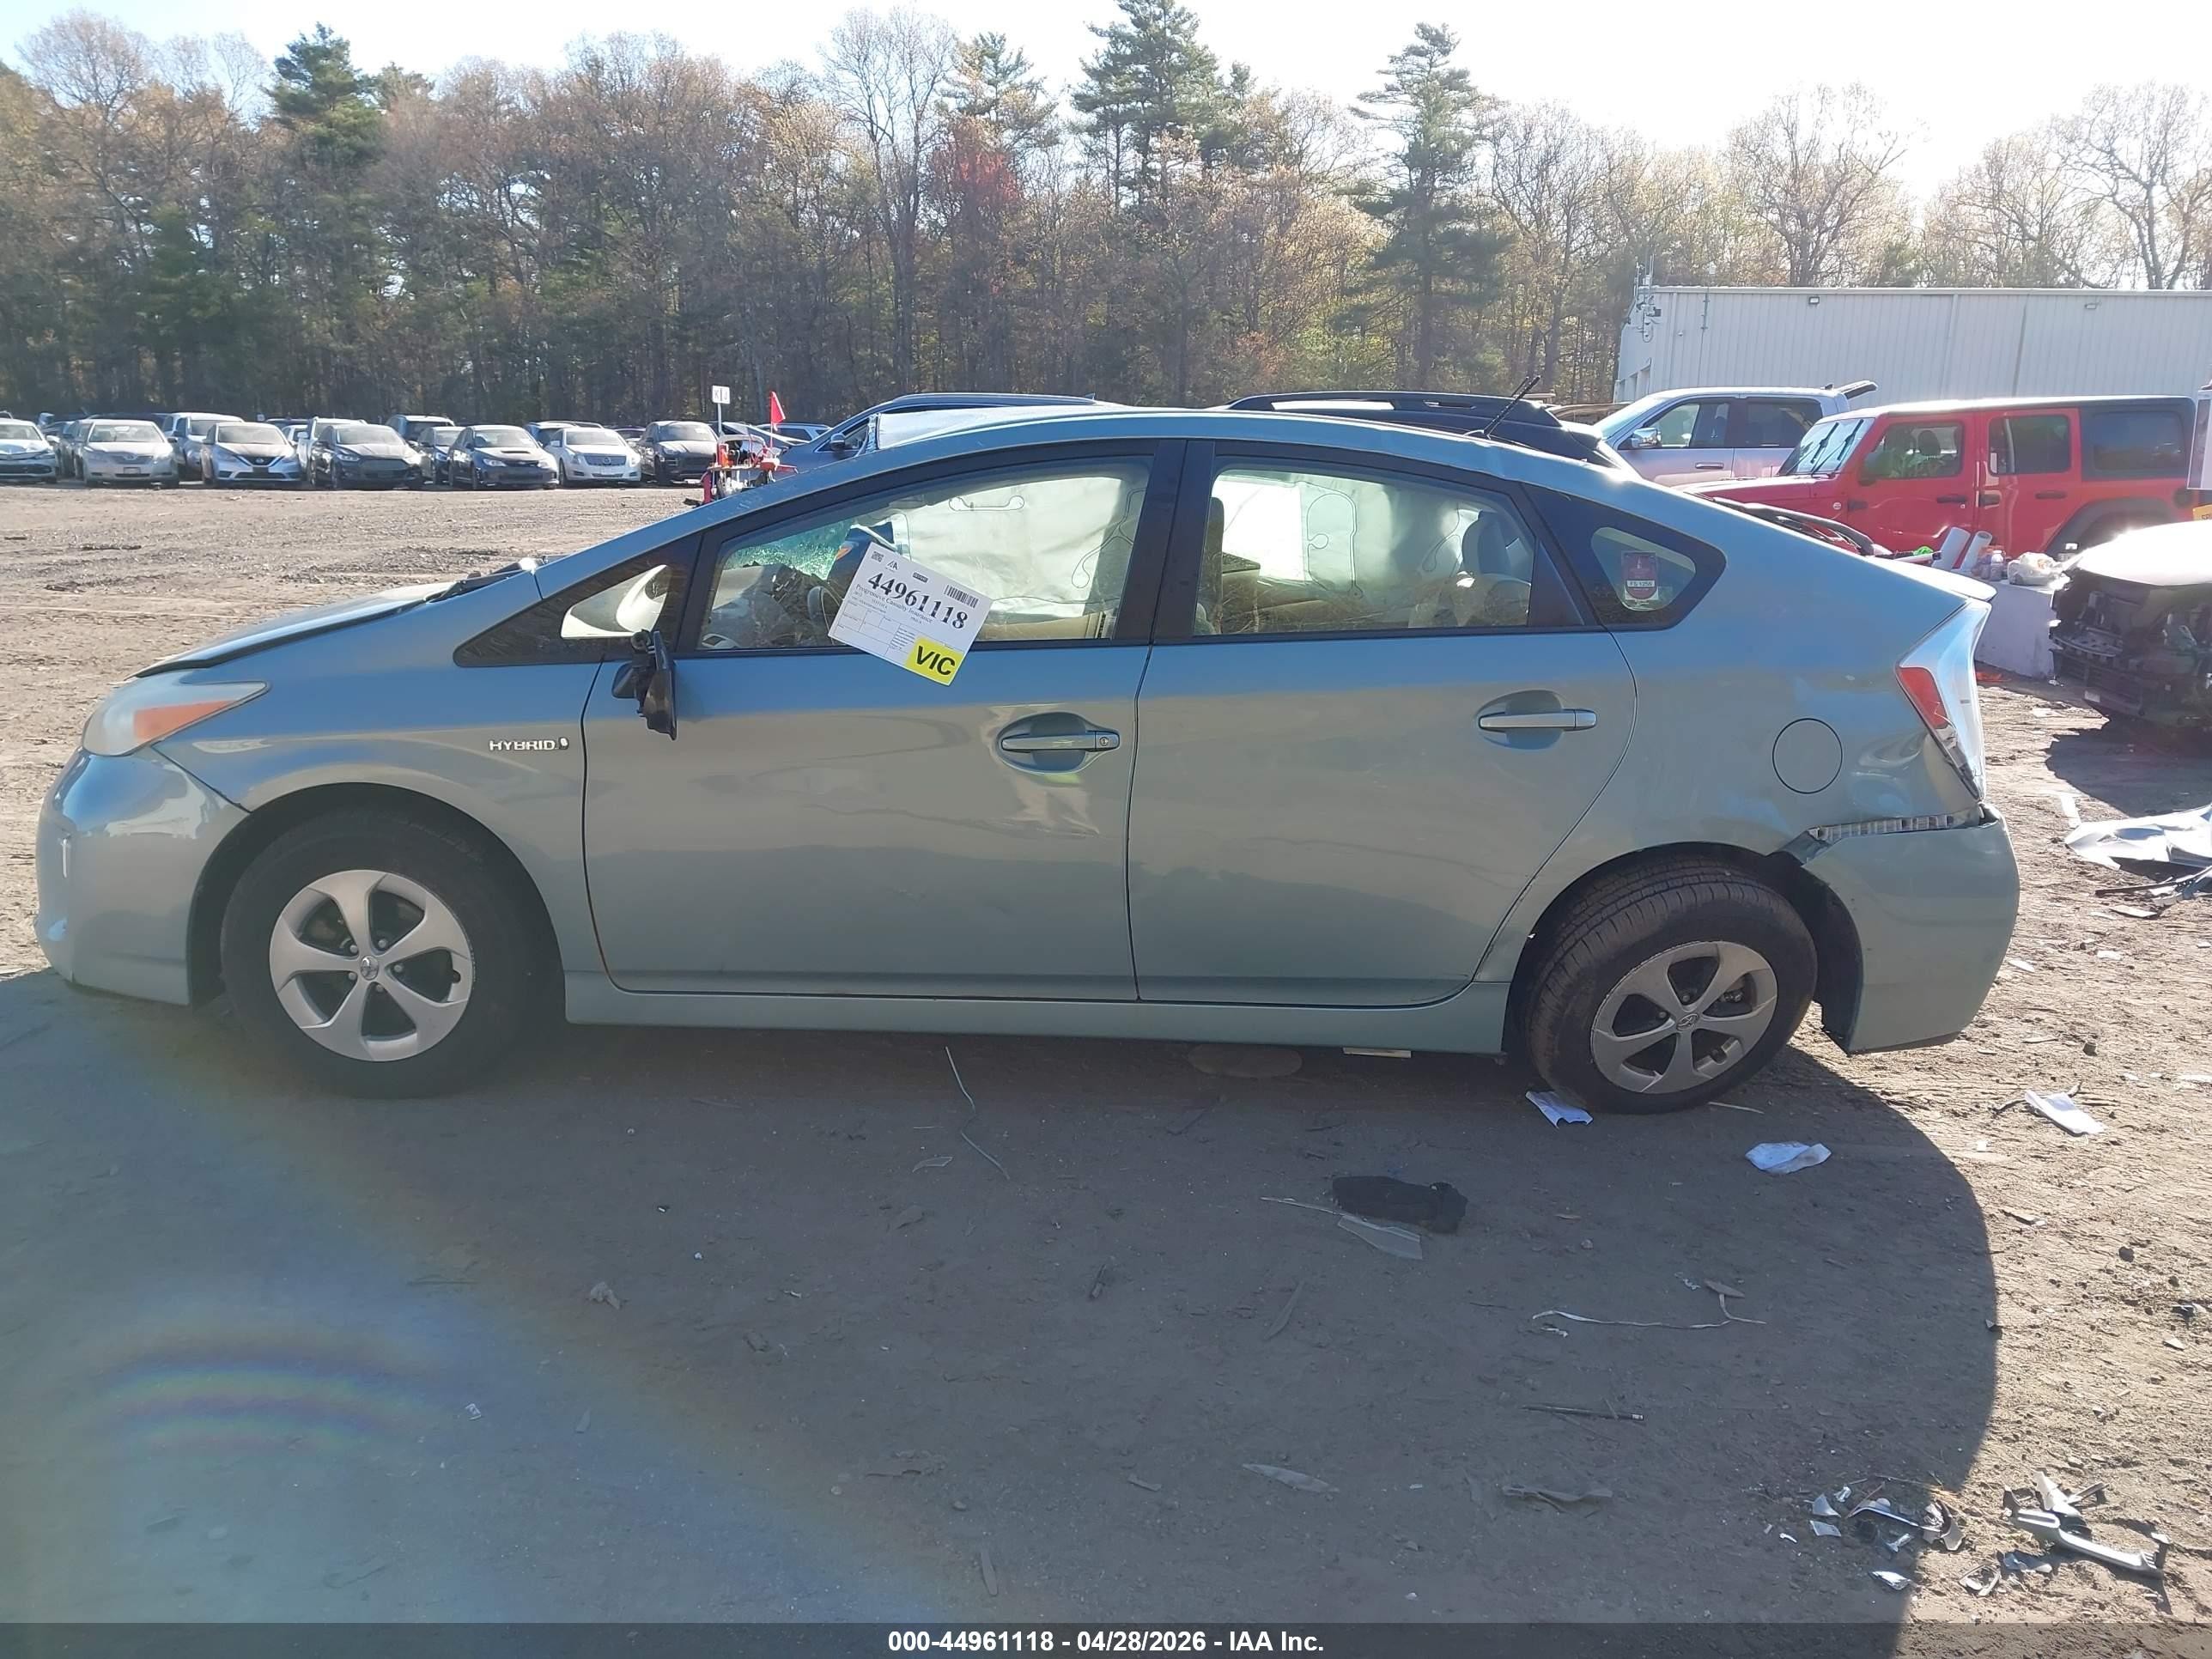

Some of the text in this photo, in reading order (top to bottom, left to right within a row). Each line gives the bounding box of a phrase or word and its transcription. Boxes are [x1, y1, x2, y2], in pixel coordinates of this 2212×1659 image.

[868, 573, 969, 629] 44961118
[915, 645, 956, 676] VIC
[489, 739, 556, 750] HYBRID
